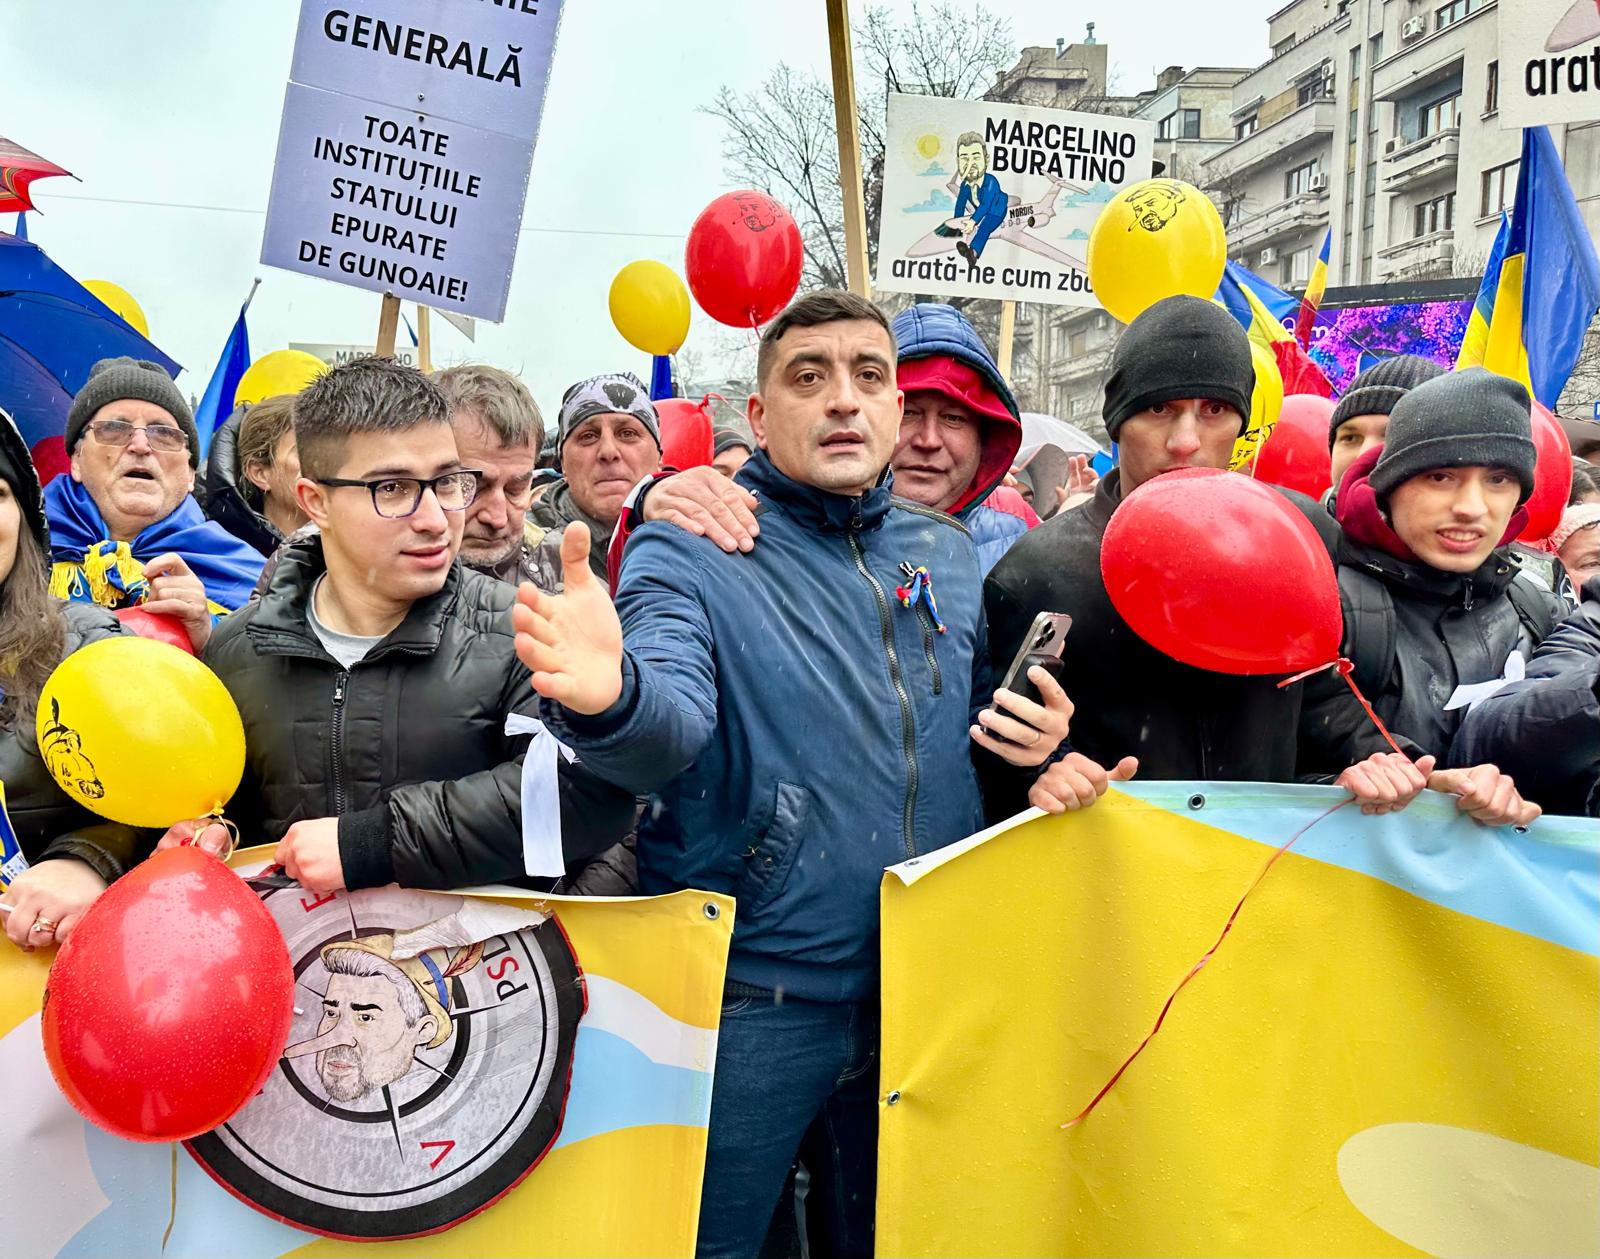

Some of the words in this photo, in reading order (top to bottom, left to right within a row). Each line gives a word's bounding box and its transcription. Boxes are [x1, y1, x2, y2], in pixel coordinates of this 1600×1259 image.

[324, 9, 523, 88] GENERALĂ
[364, 115, 449, 157] TOATE
[985, 117, 1136, 159] MARCELINO
[313, 136, 481, 198] INSTITUȚIILE
[992, 145, 1125, 185] BURATINO
[330, 177, 458, 229] STATULUI
[330, 212, 448, 261] EPURATE
[298, 240, 333, 268] DE
[339, 251, 469, 303] GUNOAIE!
[892, 256, 996, 285] arată-ne
[1002, 268, 1051, 290] cum
